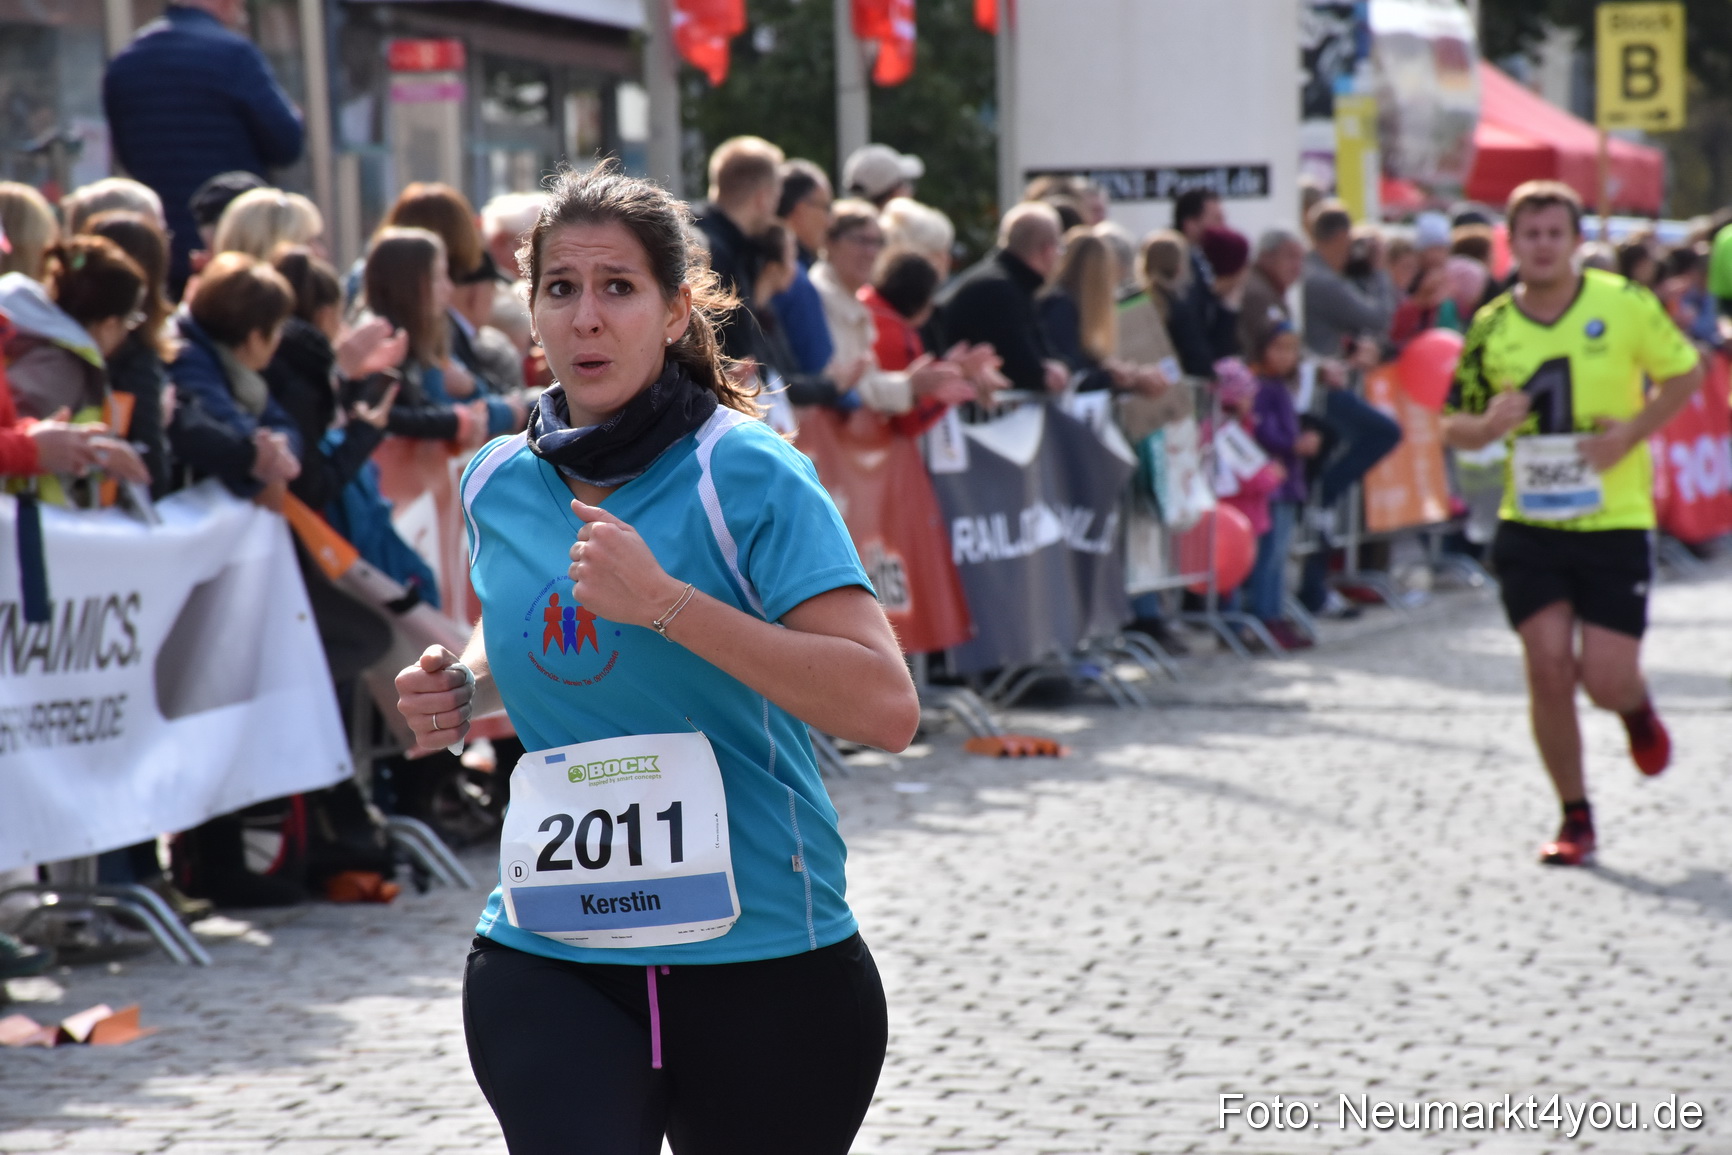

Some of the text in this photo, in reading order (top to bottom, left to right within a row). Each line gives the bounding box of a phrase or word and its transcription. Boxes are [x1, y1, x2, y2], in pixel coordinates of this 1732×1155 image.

[1620, 43, 1661, 101] B
[587, 755, 661, 780] BOCK
[588, 777, 609, 787] inspired
[634, 773, 663, 781] concepts
[536, 800, 685, 873] 2011
[514, 866, 523, 878] D
[580, 890, 661, 915] Kerstin
